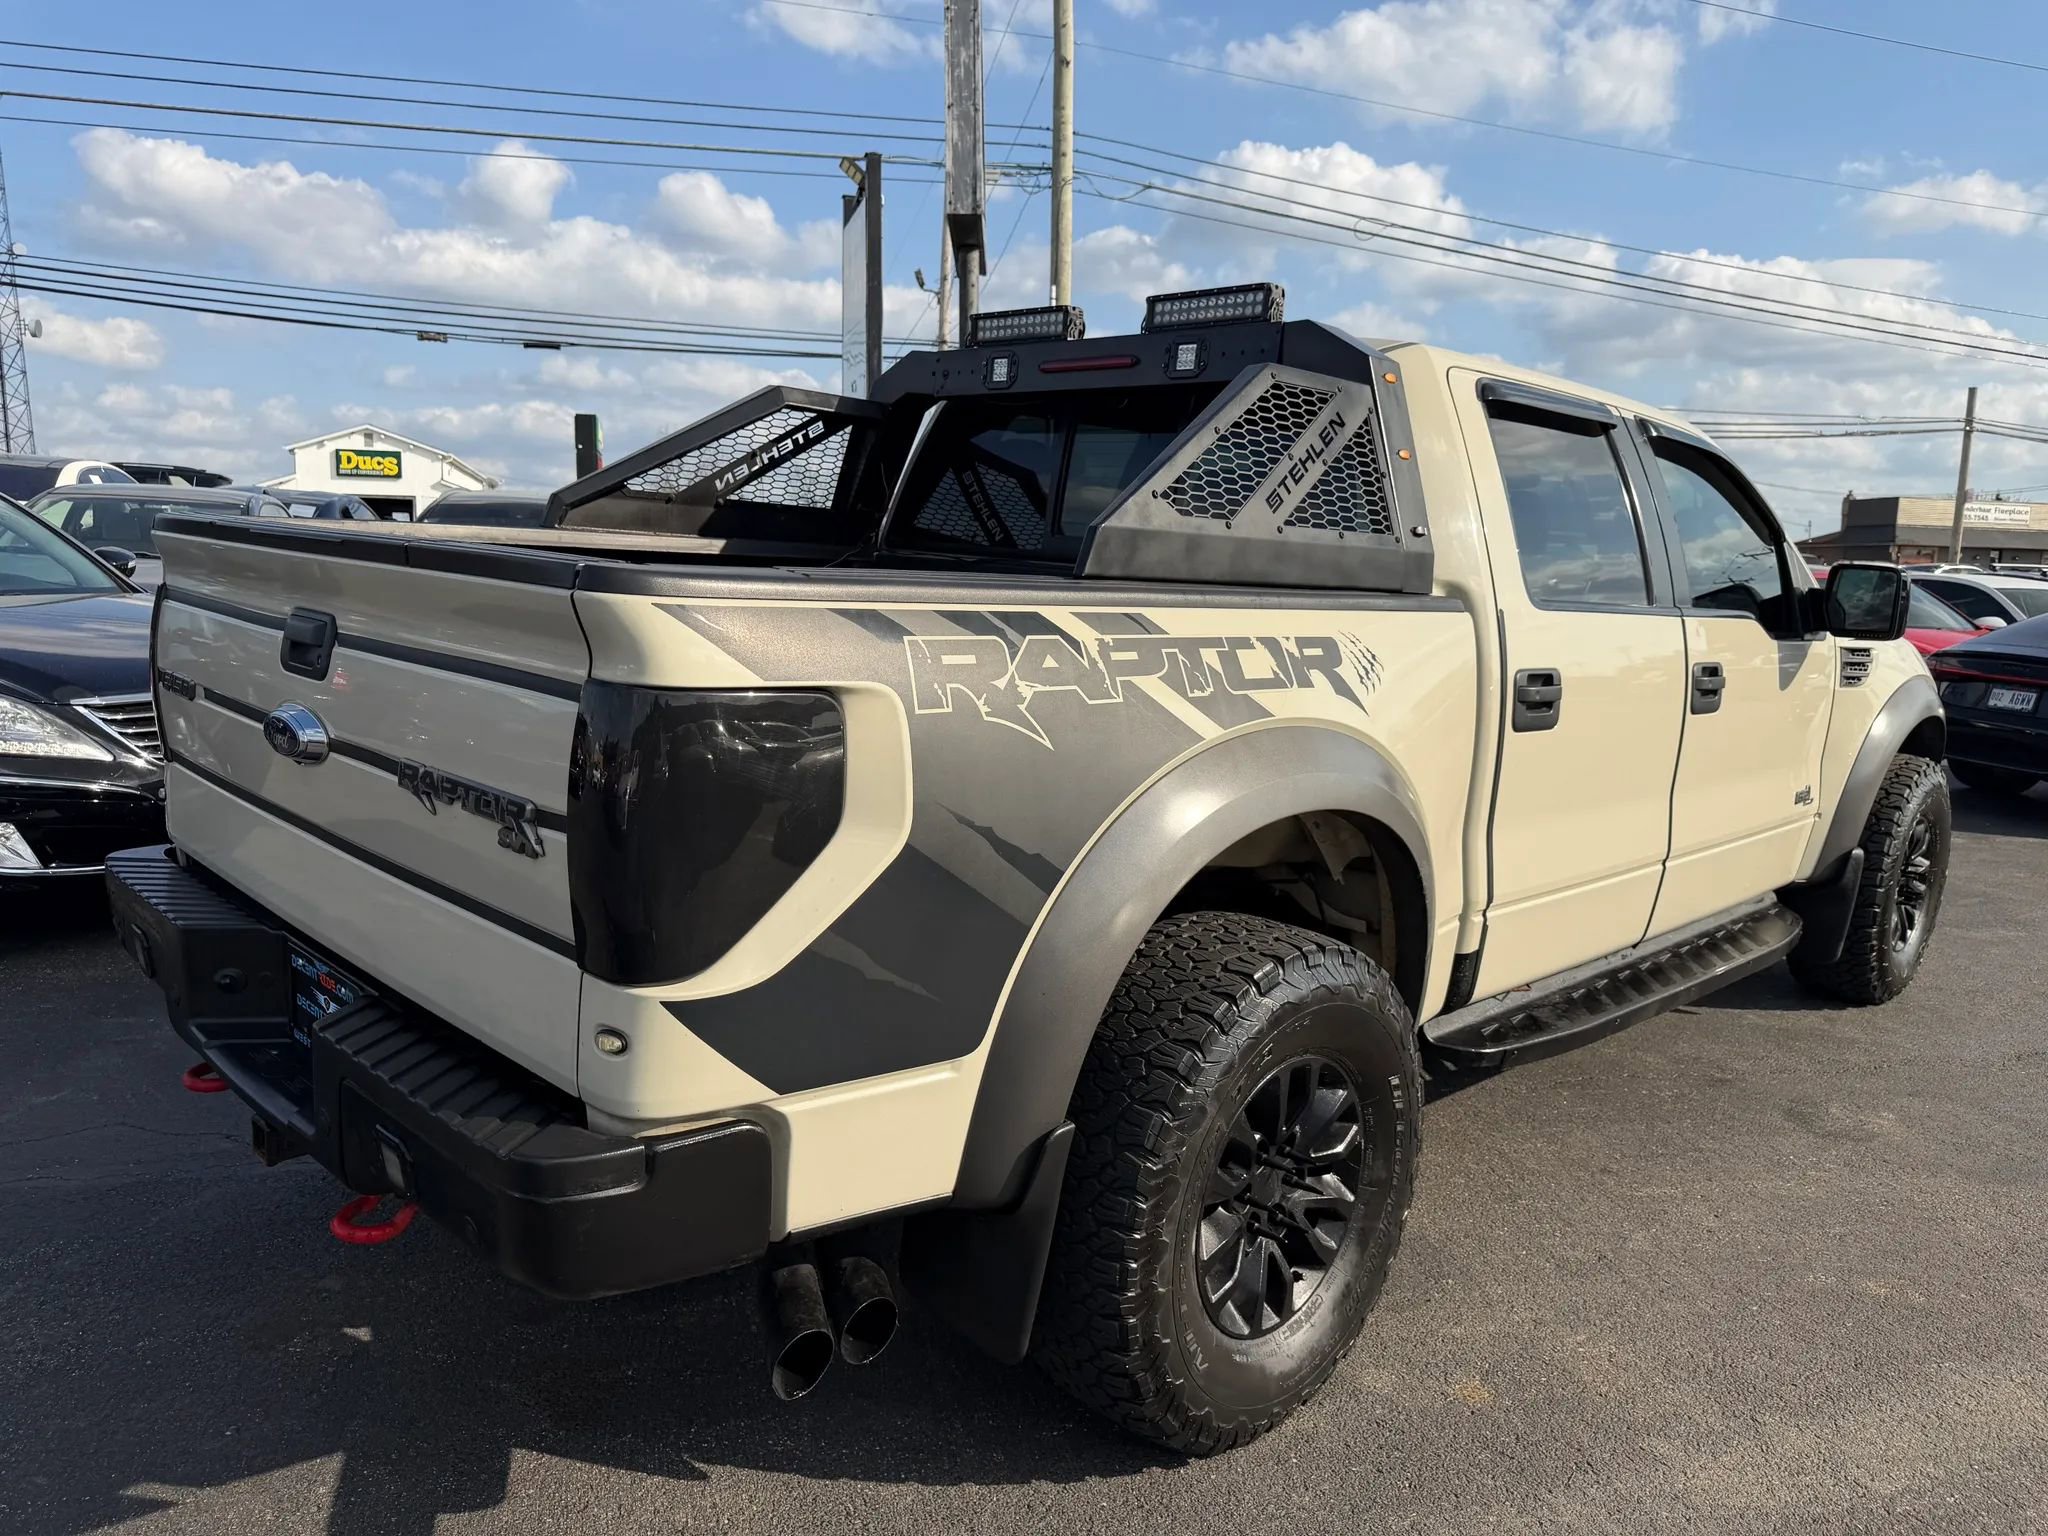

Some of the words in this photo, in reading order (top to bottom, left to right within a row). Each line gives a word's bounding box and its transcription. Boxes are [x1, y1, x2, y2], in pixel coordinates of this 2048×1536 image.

[339, 451, 399, 476] Ducs
[962, 470, 1005, 541] STEHLEN
[1265, 411, 1346, 514] STEHLEN
[902, 635, 1369, 751] RAPTOR
[398, 757, 546, 858] RAPTOR
